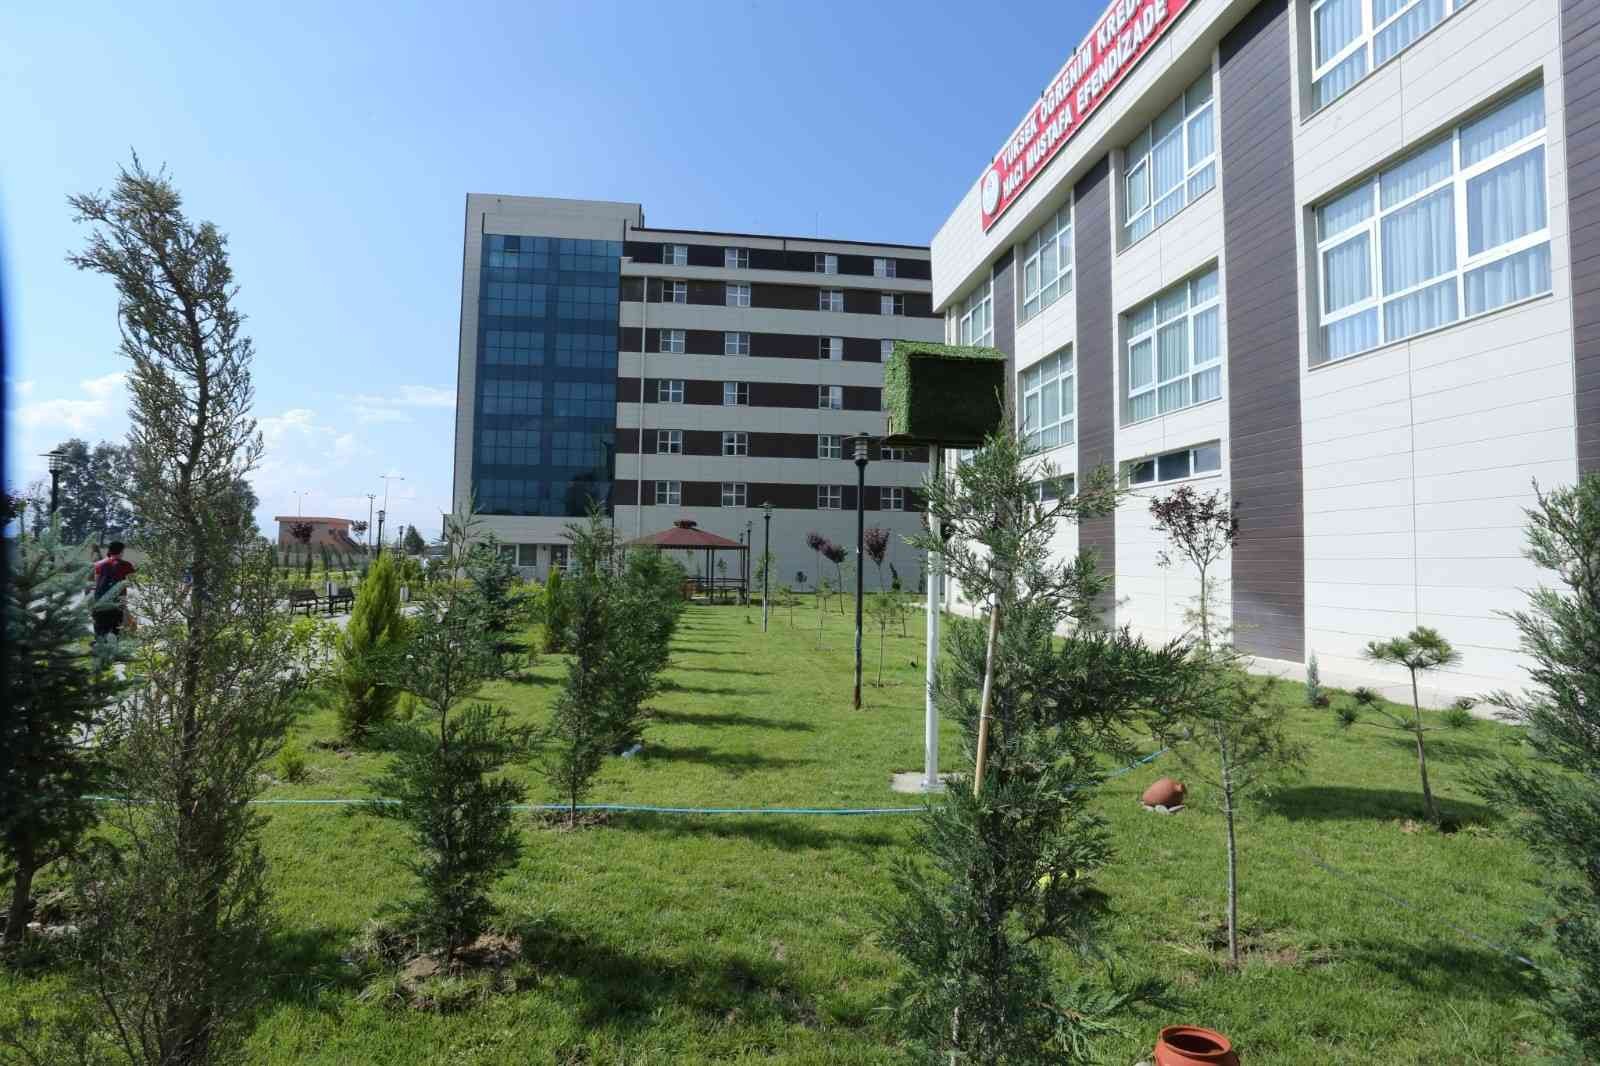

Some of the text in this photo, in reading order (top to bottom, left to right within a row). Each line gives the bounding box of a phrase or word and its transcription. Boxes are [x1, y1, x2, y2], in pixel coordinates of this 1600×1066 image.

[1097, 0, 1141, 53] KRED
[1002, 160, 1024, 199] HACI
[1025, 103, 1073, 174] MUSTAFA
